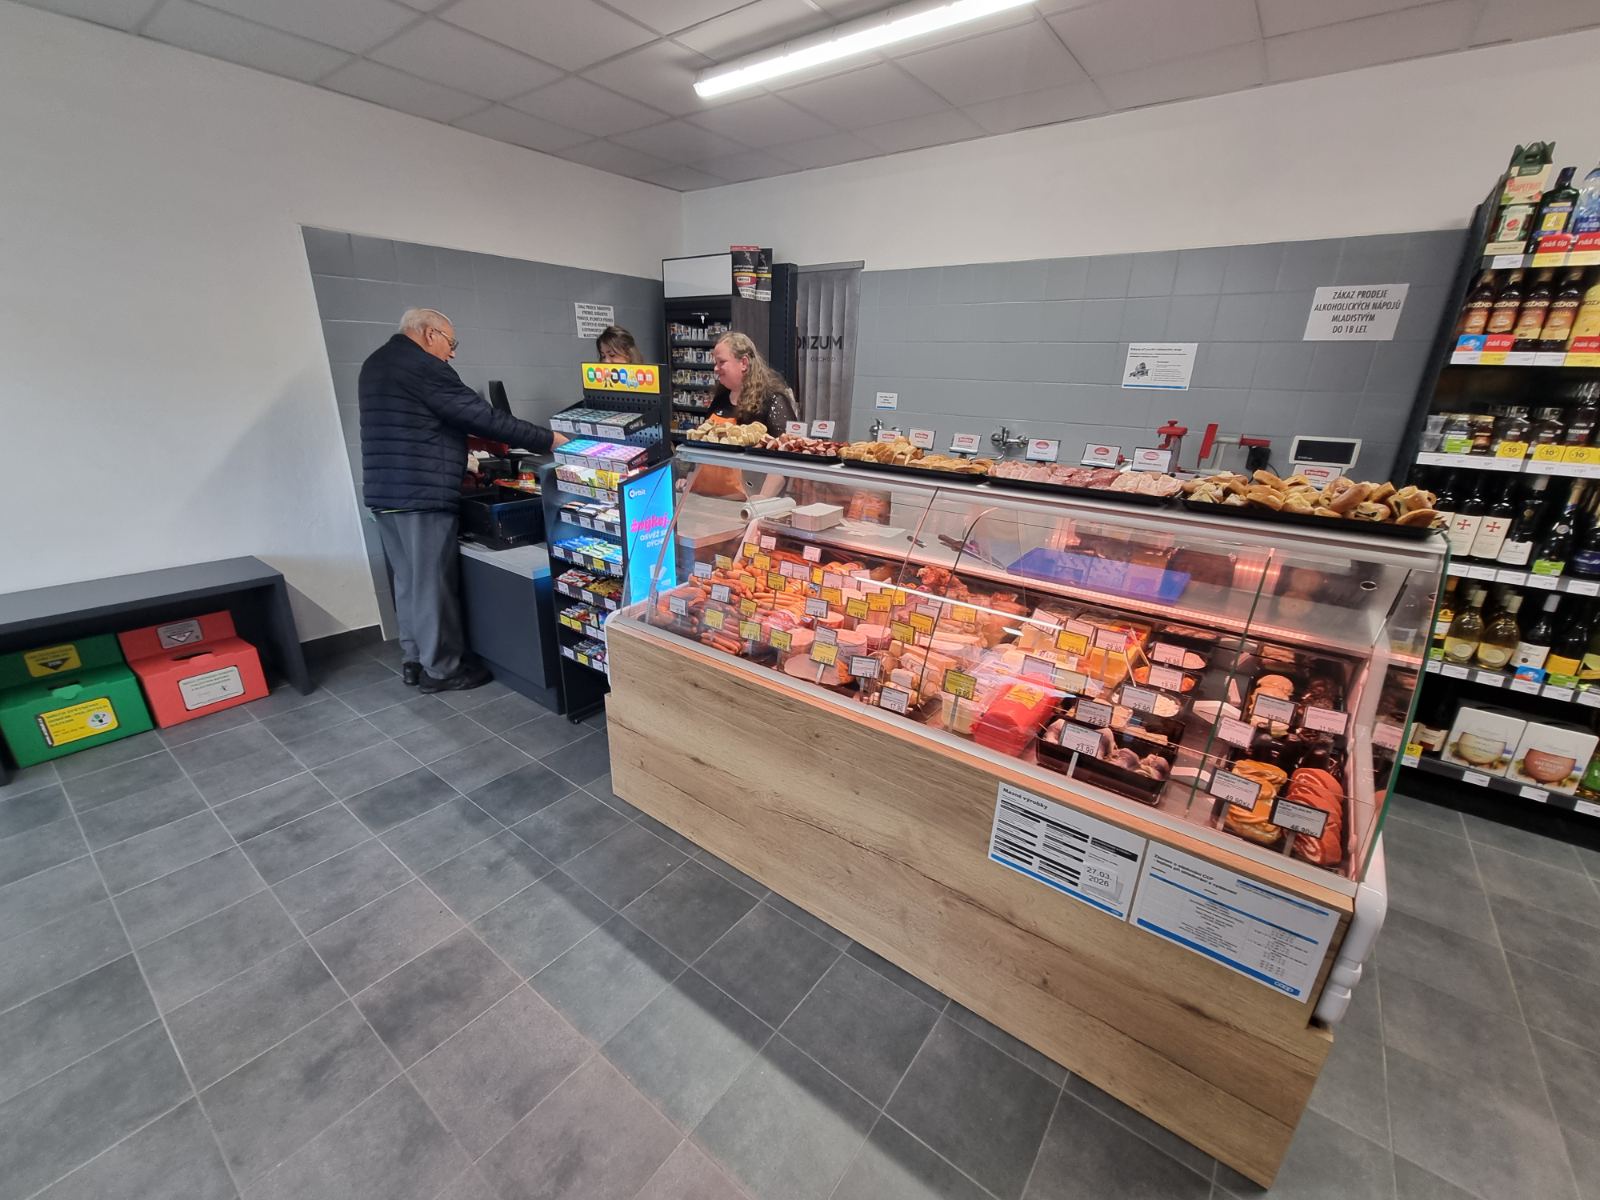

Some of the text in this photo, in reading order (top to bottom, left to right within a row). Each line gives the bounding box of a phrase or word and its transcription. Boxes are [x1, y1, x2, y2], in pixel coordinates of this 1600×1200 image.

[1333, 290, 1388, 299] ZÁKAZ PRODEJE
[1314, 299, 1401, 311] ALKOHOLICKÝCH NÁPOJŮ
[1331, 312, 1375, 322] MLADISTVÝM
[1332, 325, 1343, 333] DO
[629, 489, 646, 498] Orbit
[1088, 874, 1109, 887] 2026
